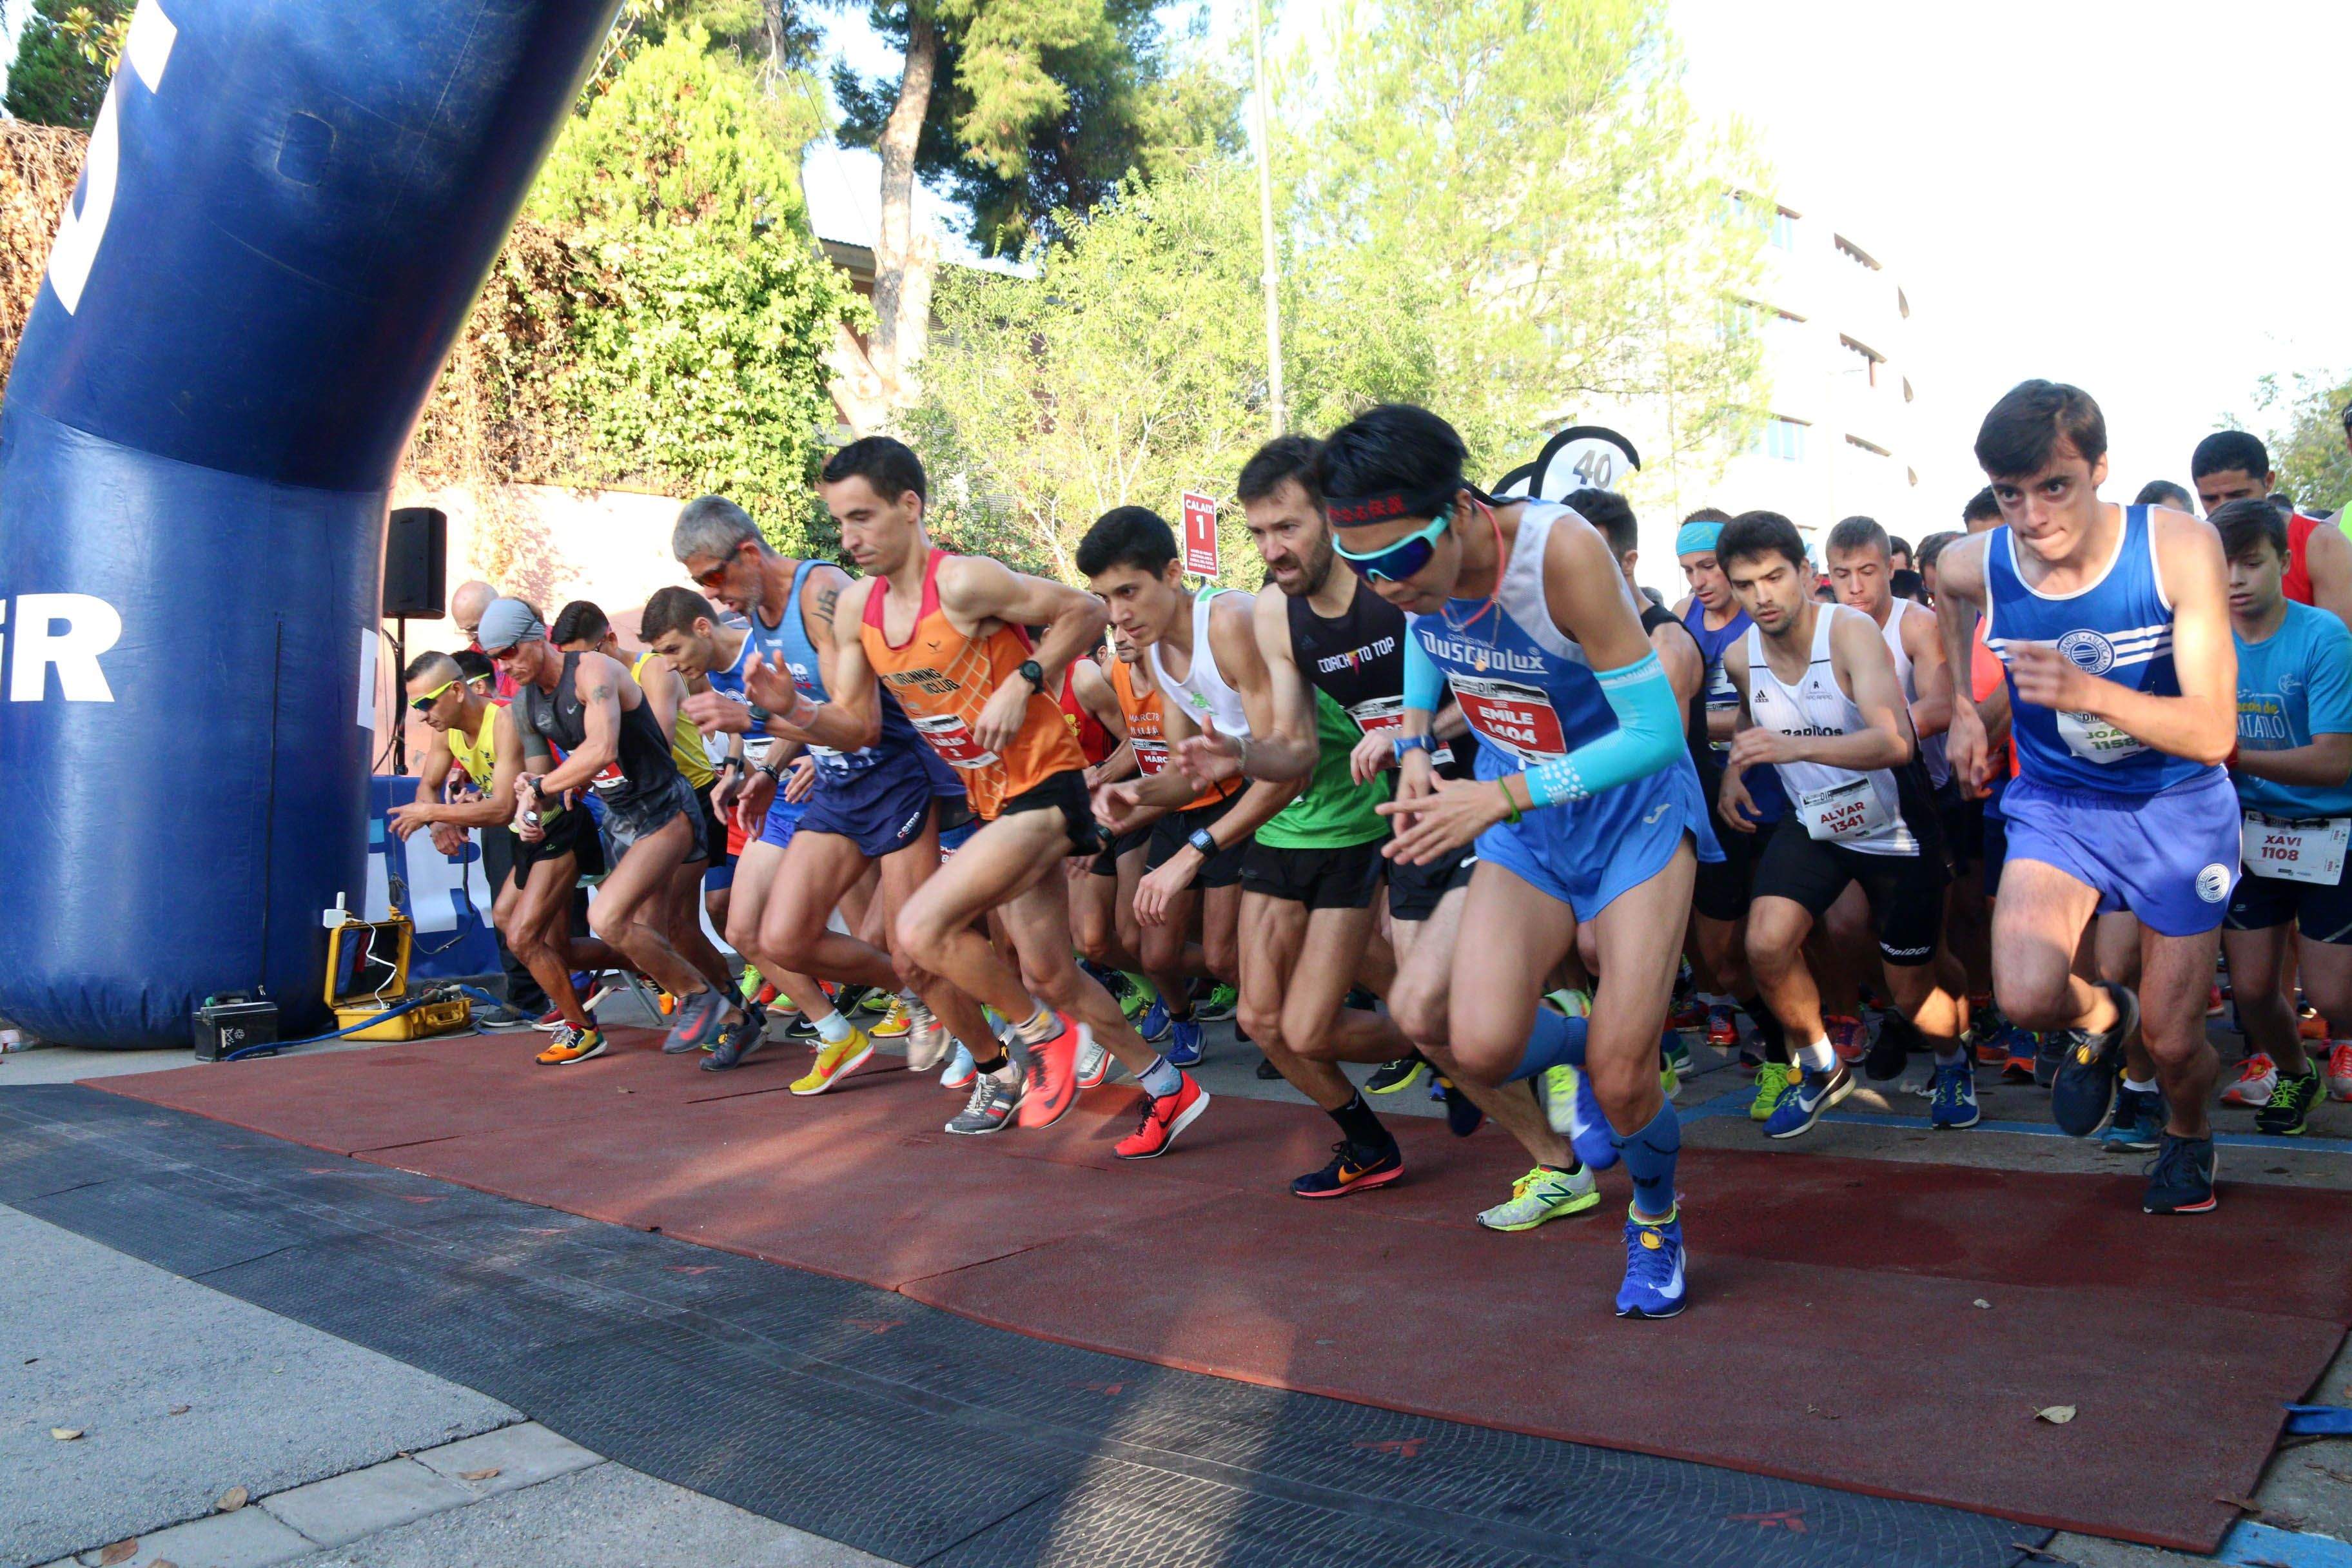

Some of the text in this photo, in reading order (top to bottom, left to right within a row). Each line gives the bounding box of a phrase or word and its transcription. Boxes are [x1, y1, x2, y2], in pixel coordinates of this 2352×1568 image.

[1573, 449, 1611, 489] 40
[1186, 499, 1213, 514] CALAIX
[1196, 514, 1204, 540] 1
[1317, 636, 1395, 673] COACH TO TOP
[896, 668, 943, 685] RUNNING
[926, 679, 961, 694] CLUB
[1478, 706, 1534, 725] EMILE
[1485, 720, 1537, 745] 1404
[2092, 737, 2138, 750] 1158
[1144, 755, 1168, 763] MARC
[1821, 801, 1865, 824] ALVAR
[1830, 814, 1865, 833] 1341
[2264, 835, 2302, 847] XAVI
[2261, 847, 2300, 861] 1108
